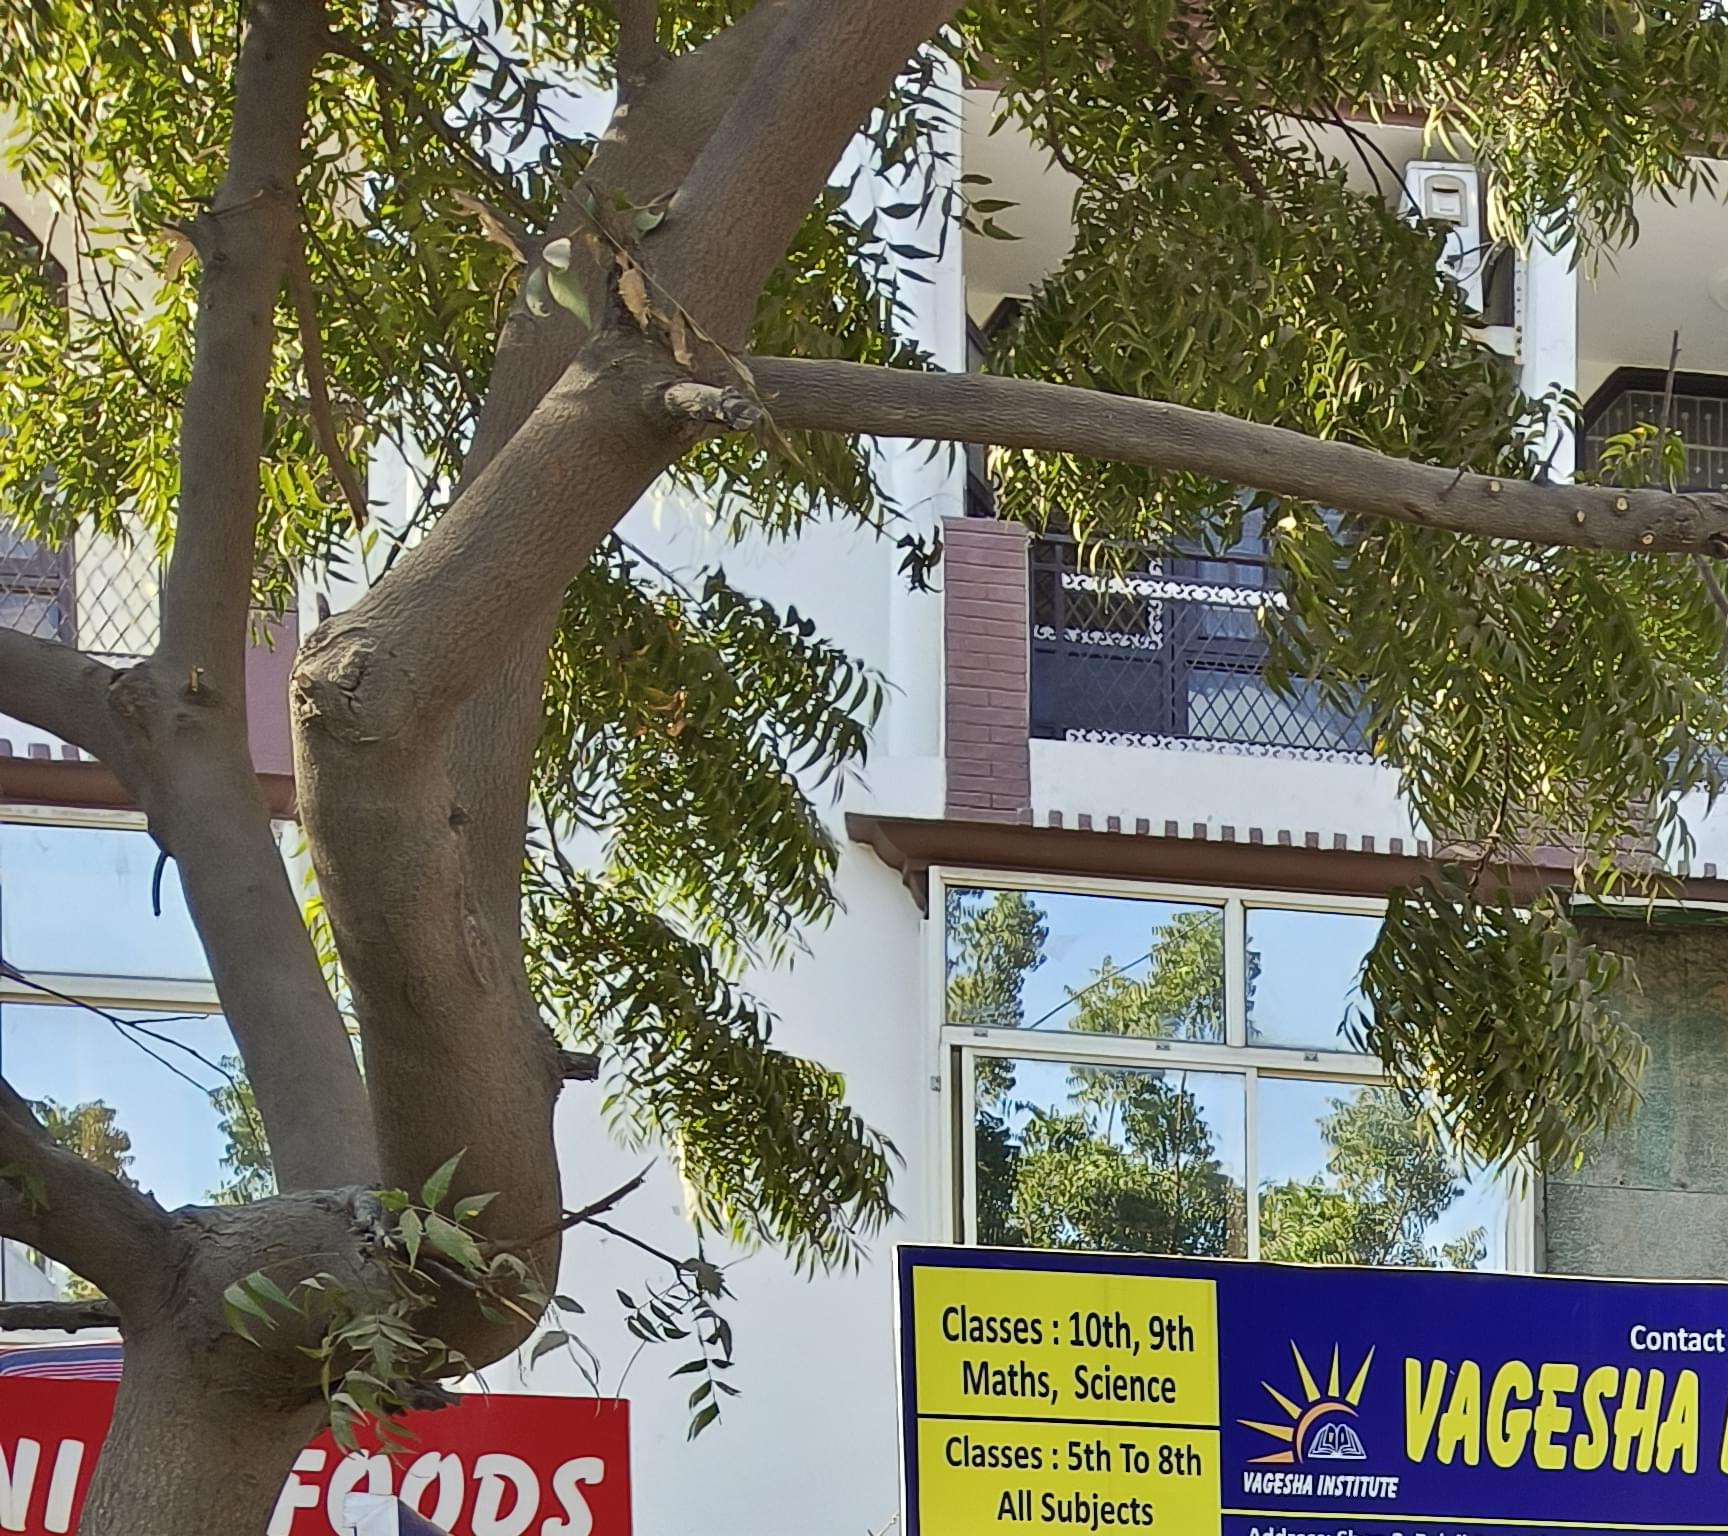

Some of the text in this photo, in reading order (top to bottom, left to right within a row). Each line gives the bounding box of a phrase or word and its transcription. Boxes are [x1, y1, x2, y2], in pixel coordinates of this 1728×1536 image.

[942, 1305, 1195, 1357] Classes 10th, 9th
[1630, 1325, 1725, 1354] Contact
[962, 1360, 1177, 1405] Maths, Science
[1404, 1356, 1699, 1477] VAGESHA
[945, 1435, 1202, 1478] Classes 5th To 8th
[1243, 1471, 1399, 1501] VAGESHA INSTITUTE
[998, 1490, 1154, 1531] All Subjects
